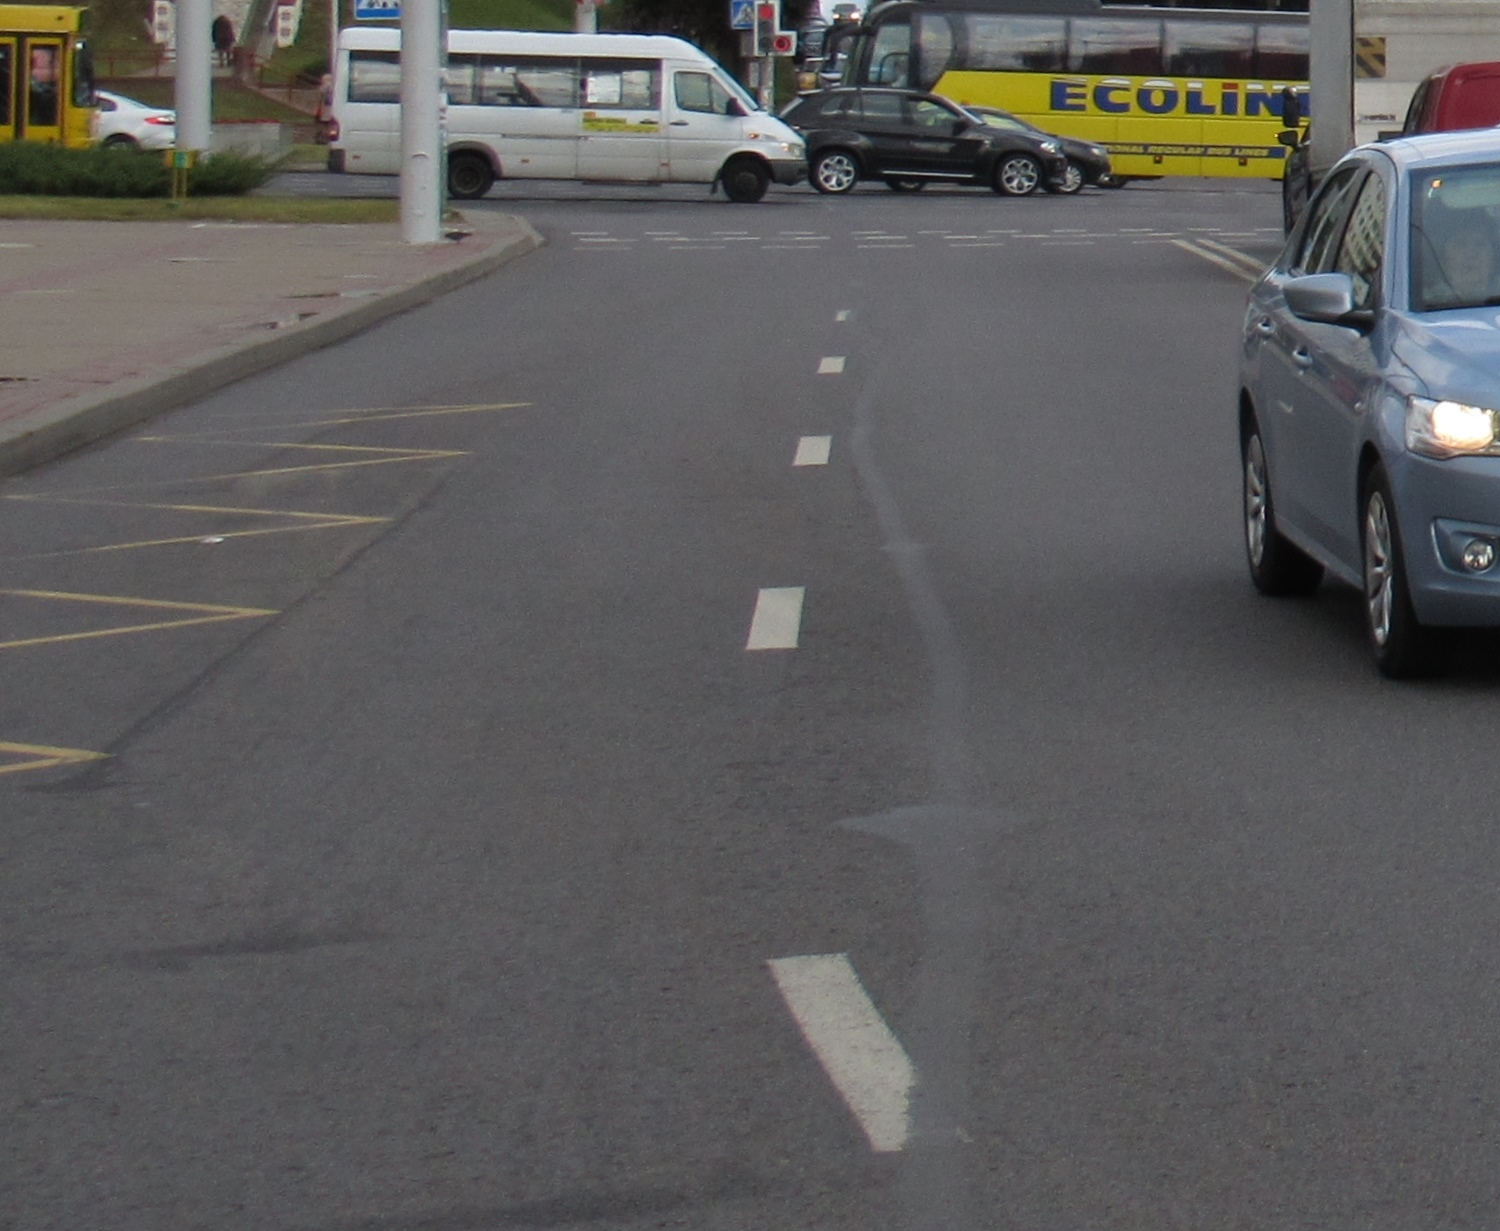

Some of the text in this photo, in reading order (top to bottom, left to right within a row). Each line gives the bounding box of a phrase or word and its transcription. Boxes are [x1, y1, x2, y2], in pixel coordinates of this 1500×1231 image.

[1148, 145, 1205, 155] REGULAR
[1207, 147, 1232, 155] BUS
[1235, 147, 1269, 156] LINES
